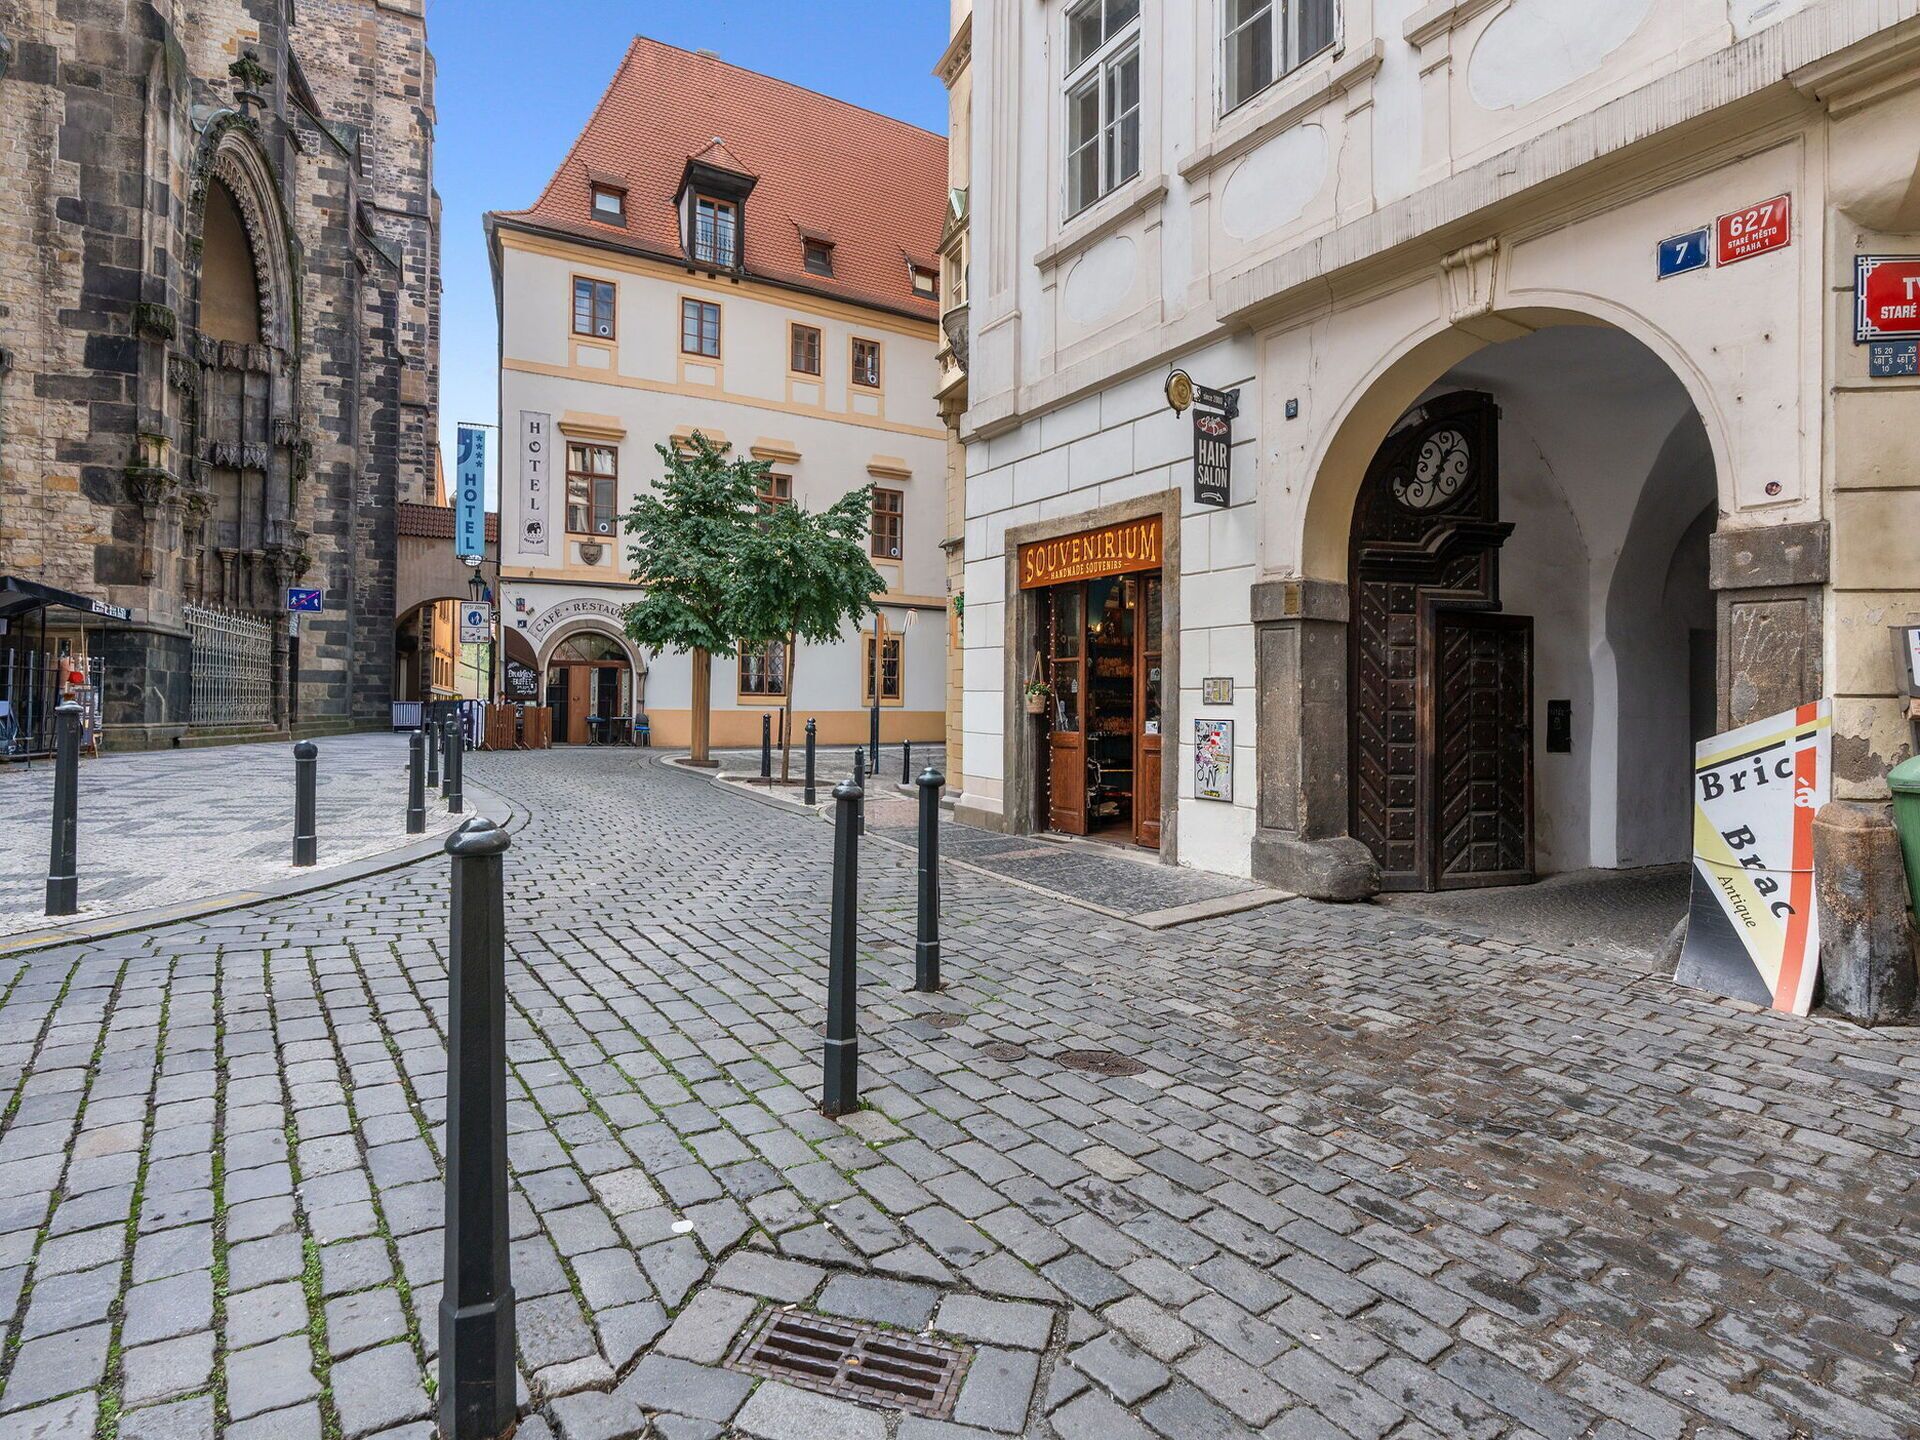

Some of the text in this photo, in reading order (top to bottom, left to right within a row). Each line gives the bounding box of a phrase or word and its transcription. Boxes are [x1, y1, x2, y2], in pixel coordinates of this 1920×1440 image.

[1730, 204, 1773, 237] 627
[1675, 242, 1689, 265] 7
[1728, 234, 1749, 249] STARÉ
[1735, 238, 1769, 255] PRAHA 1
[1880, 302, 1917, 319] STARÉ
[1908, 345, 1916, 353] 20
[529, 421, 542, 511] HOTEL
[1198, 438, 1228, 468] HAIR
[1197, 464, 1228, 488] SALON
[464, 472, 478, 550] HOTEL
[1026, 522, 1156, 583] SOUVENIRIUM
[1050, 560, 1122, 580] HANDMADE SOUVENIRS
[535, 607, 563, 632] CAFÉ
[1699, 756, 1794, 802] Bric
[1721, 824, 1796, 919] Brac
[1717, 874, 1757, 929] Antique
